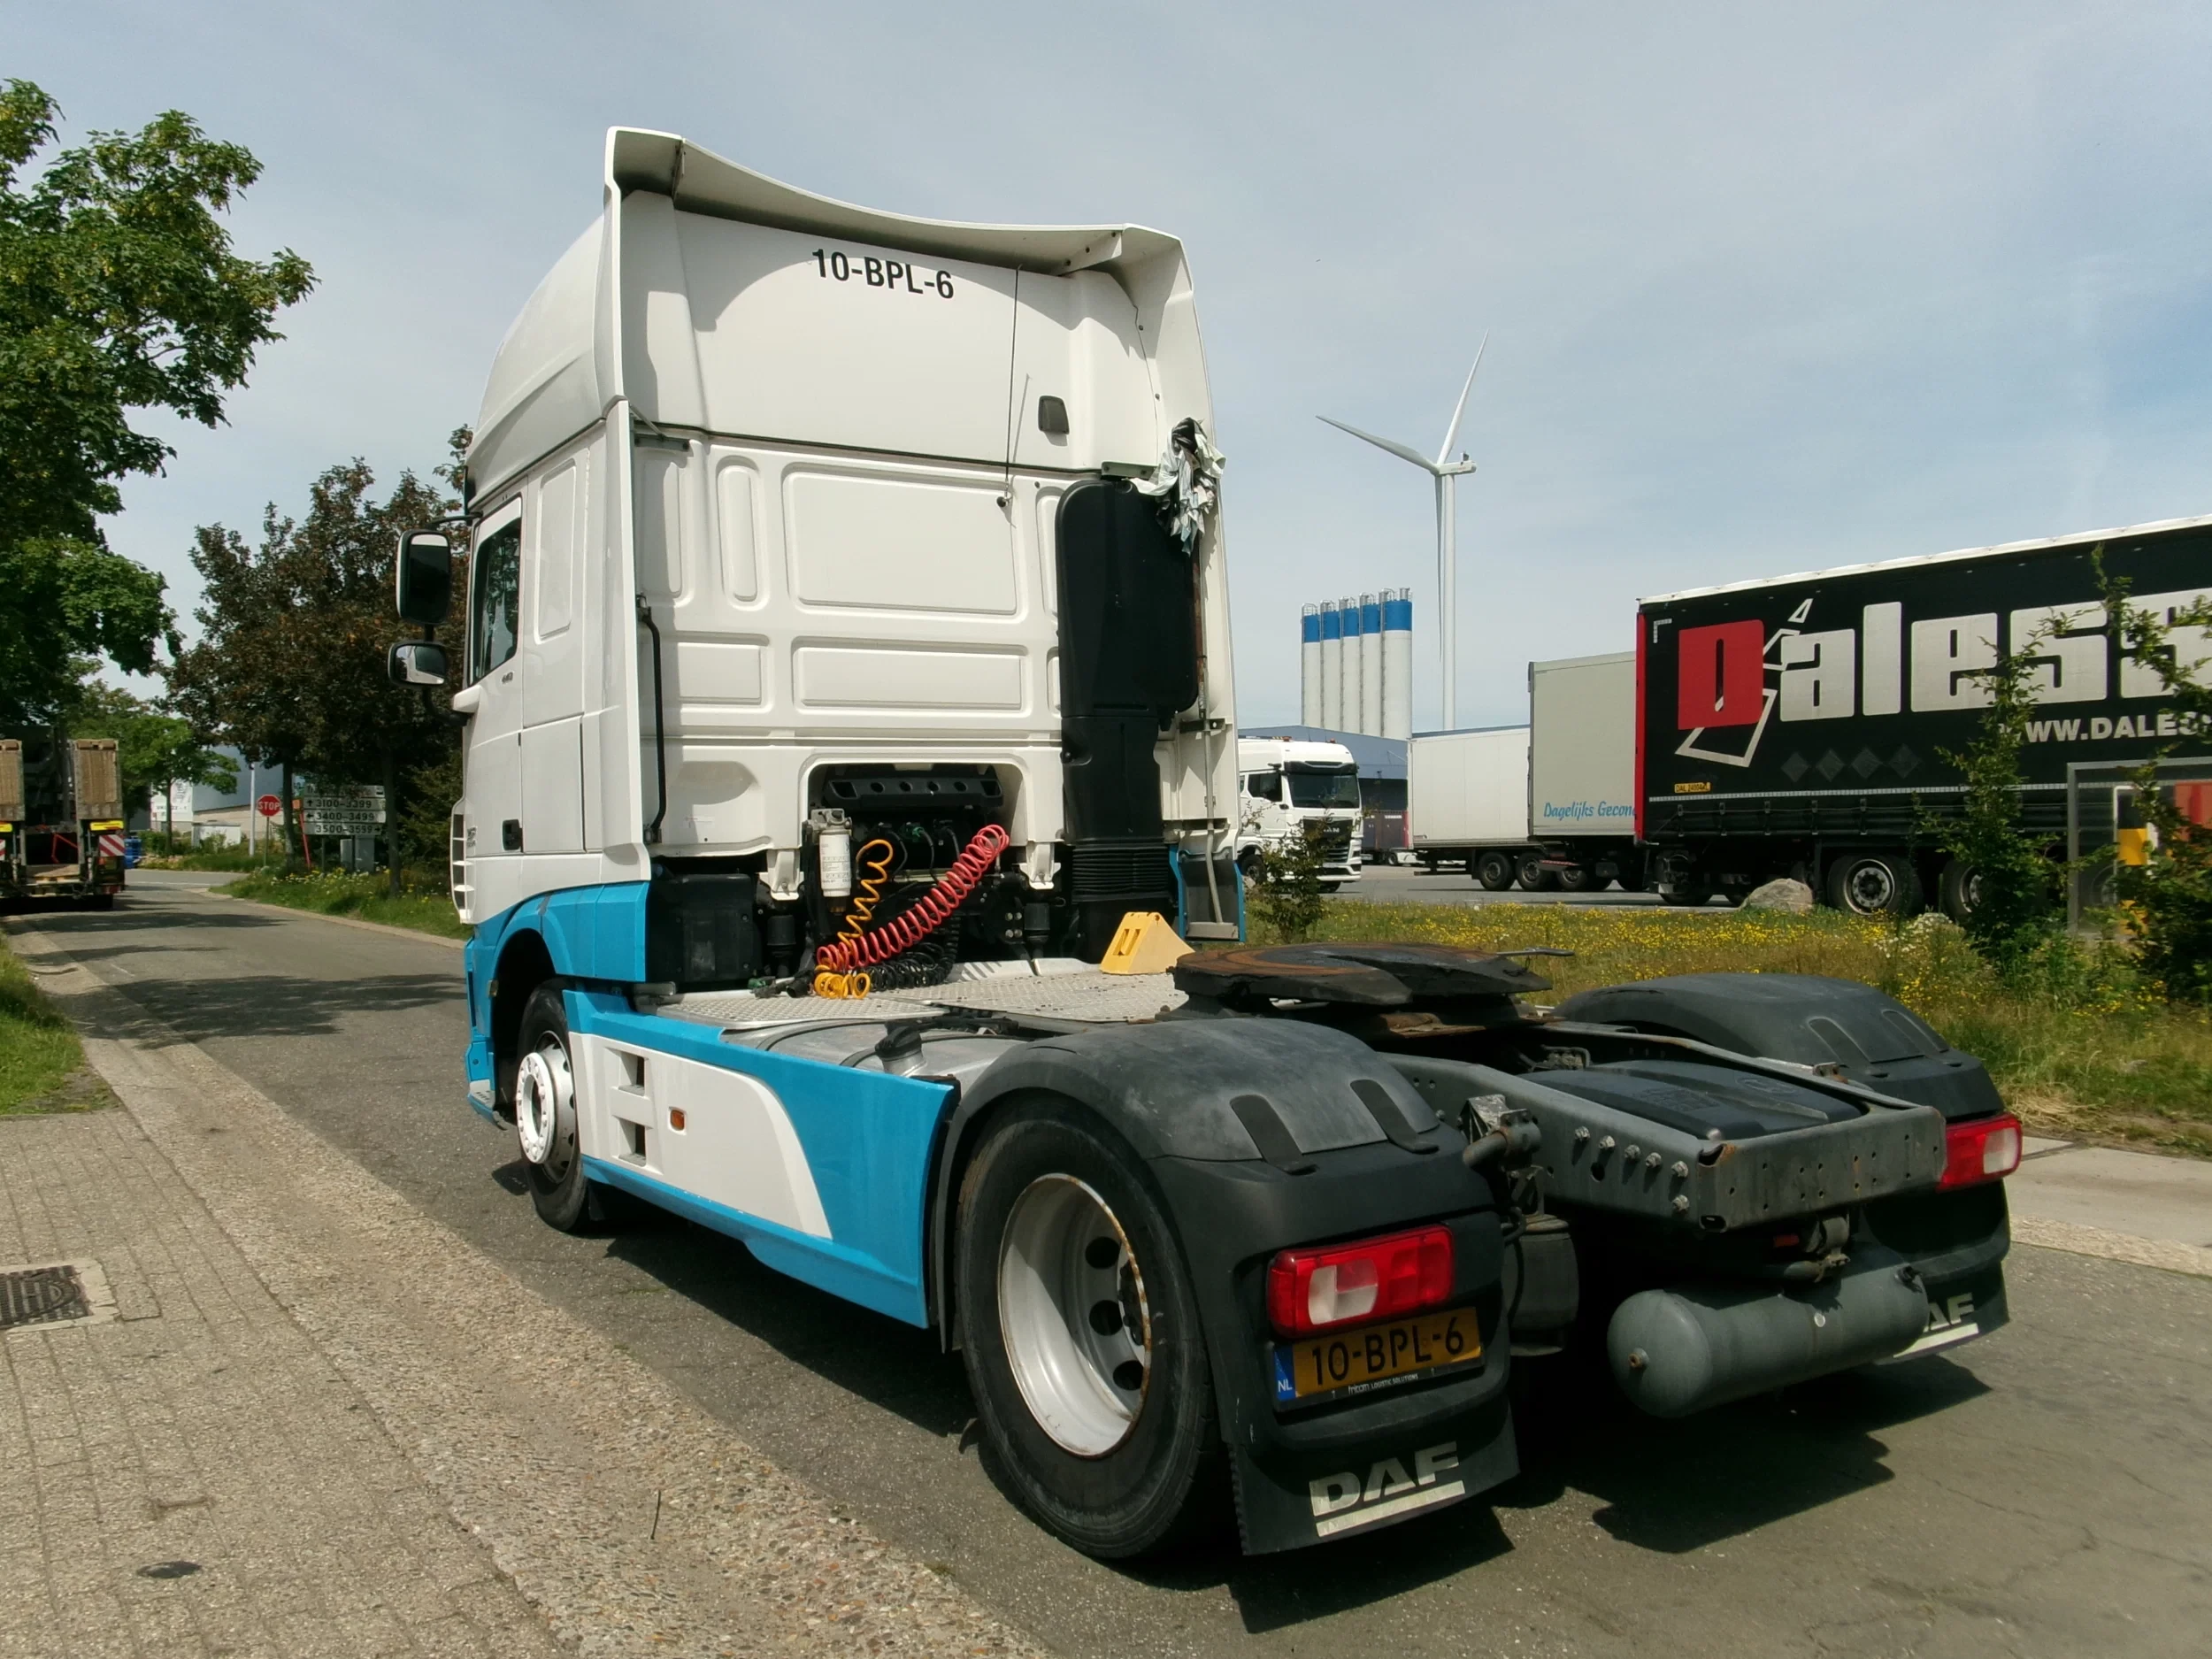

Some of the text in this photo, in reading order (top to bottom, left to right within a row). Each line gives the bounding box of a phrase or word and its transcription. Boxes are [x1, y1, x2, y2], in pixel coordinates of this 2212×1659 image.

[812, 249, 954, 299] 10-BPL-6
[258, 801, 280, 811] STOP
[1543, 801, 1594, 821] Dagelijks
[316, 810, 375, 821] 3400-3499
[1311, 1316, 1464, 1386] 10-BPL-6
[1278, 1379, 1293, 1394] NL
[1371, 1379, 1392, 1389] LOGISTIC
[1392, 1373, 1419, 1385] SOLUTIONS
[1309, 1441, 1459, 1517] DAF
